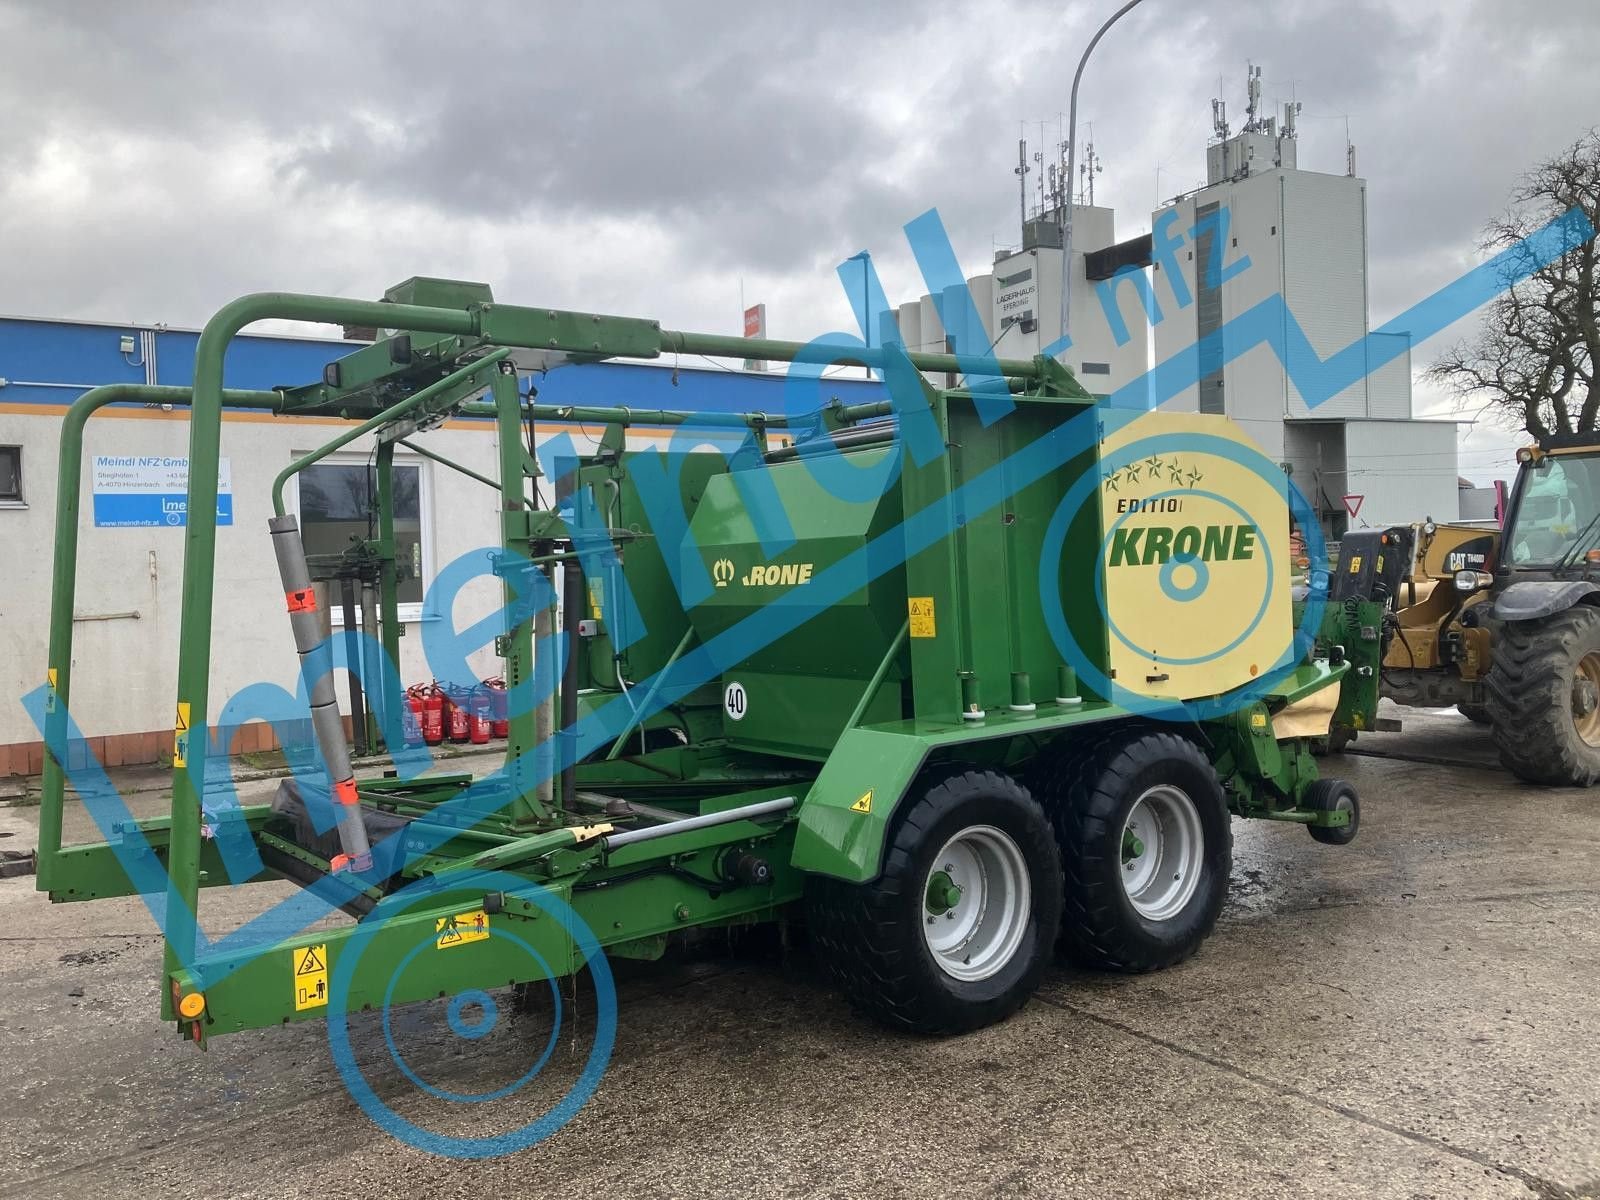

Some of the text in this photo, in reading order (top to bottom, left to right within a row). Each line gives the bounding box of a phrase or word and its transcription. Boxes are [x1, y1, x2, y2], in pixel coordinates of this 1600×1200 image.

[996, 286, 1036, 304] LAGERHAUS
[97, 457, 188, 467] Meindl NFZ Gmb
[1117, 498, 1183, 513] EDITIO
[1109, 524, 1258, 567] KRONE
[1450, 552, 1466, 570] CAT
[742, 563, 814, 587] RONE
[728, 688, 744, 714] 40
